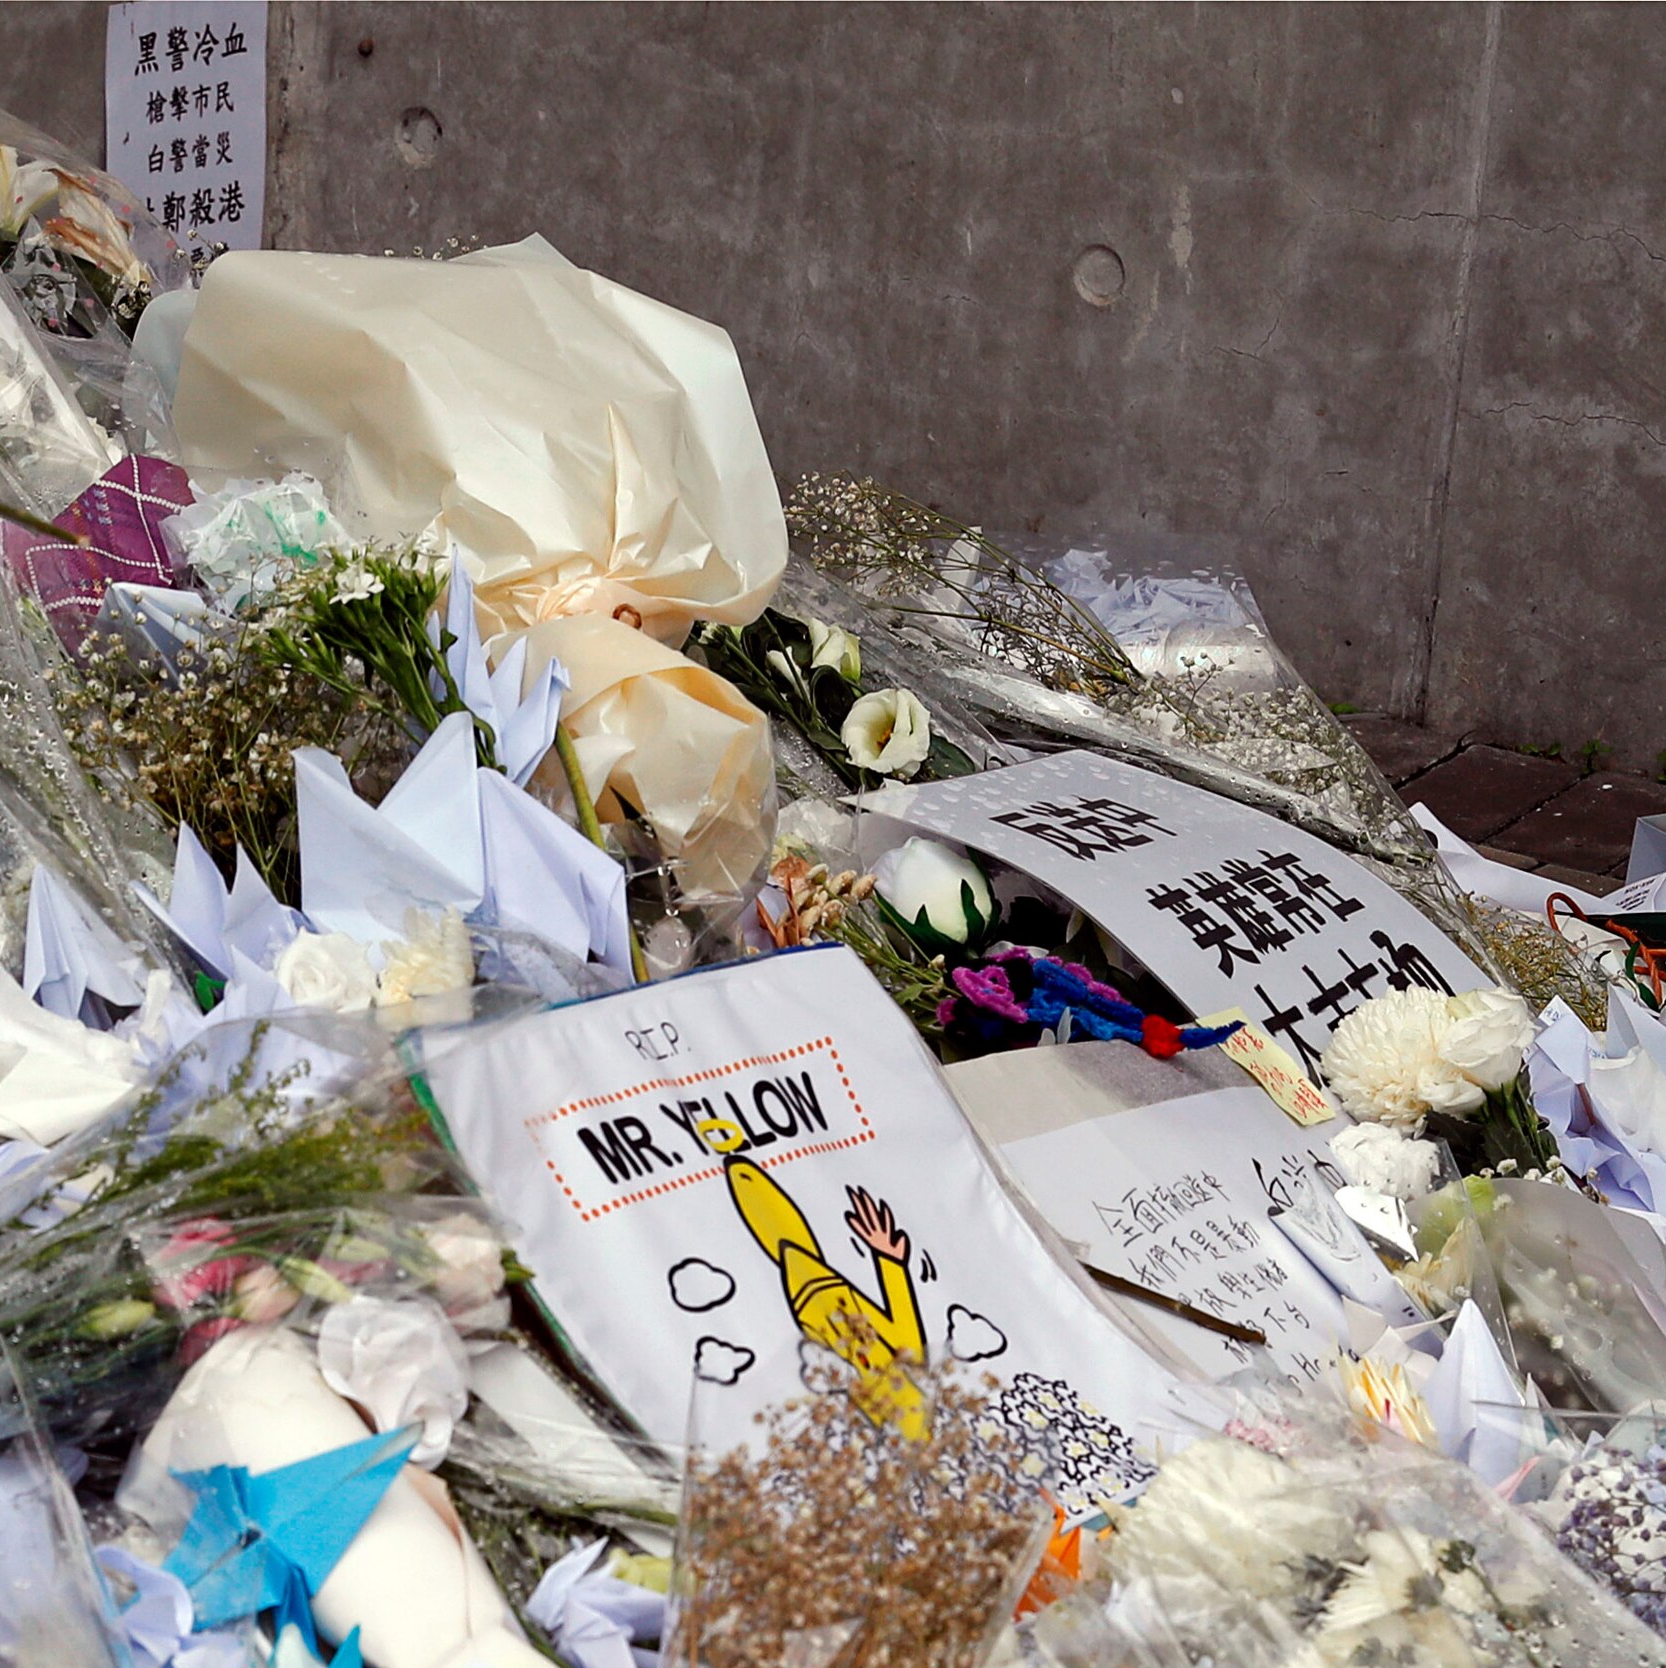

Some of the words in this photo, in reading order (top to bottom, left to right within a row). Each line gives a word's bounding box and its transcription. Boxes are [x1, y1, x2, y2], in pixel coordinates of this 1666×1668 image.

[134, 22, 248, 76] 黑警冷血
[146, 81, 234, 125] 槍擊市民
[146, 180, 245, 234] 鄭殺港
[989, 794, 1178, 862] 反送中
[1145, 849, 1366, 979] 英雄常在
[576, 1115, 683, 1184] MR.
